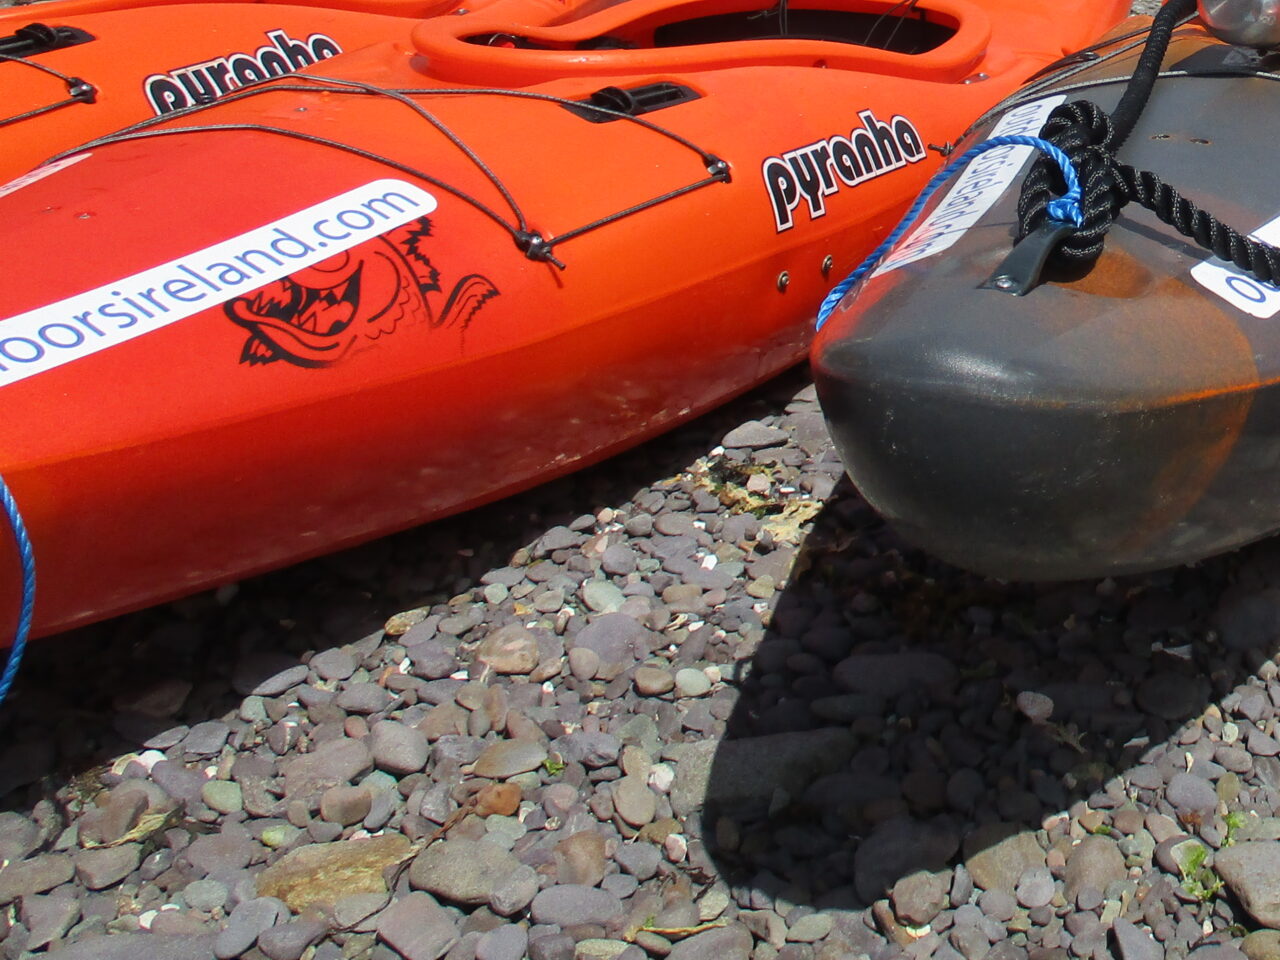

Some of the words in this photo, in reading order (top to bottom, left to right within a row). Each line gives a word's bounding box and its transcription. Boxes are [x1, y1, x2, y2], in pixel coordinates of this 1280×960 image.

[141, 27, 344, 117] pyranha
[761, 108, 928, 233] pyranha
[884, 103, 1044, 270] outdorsireland.com
[0, 187, 420, 373] oorsireland.com
